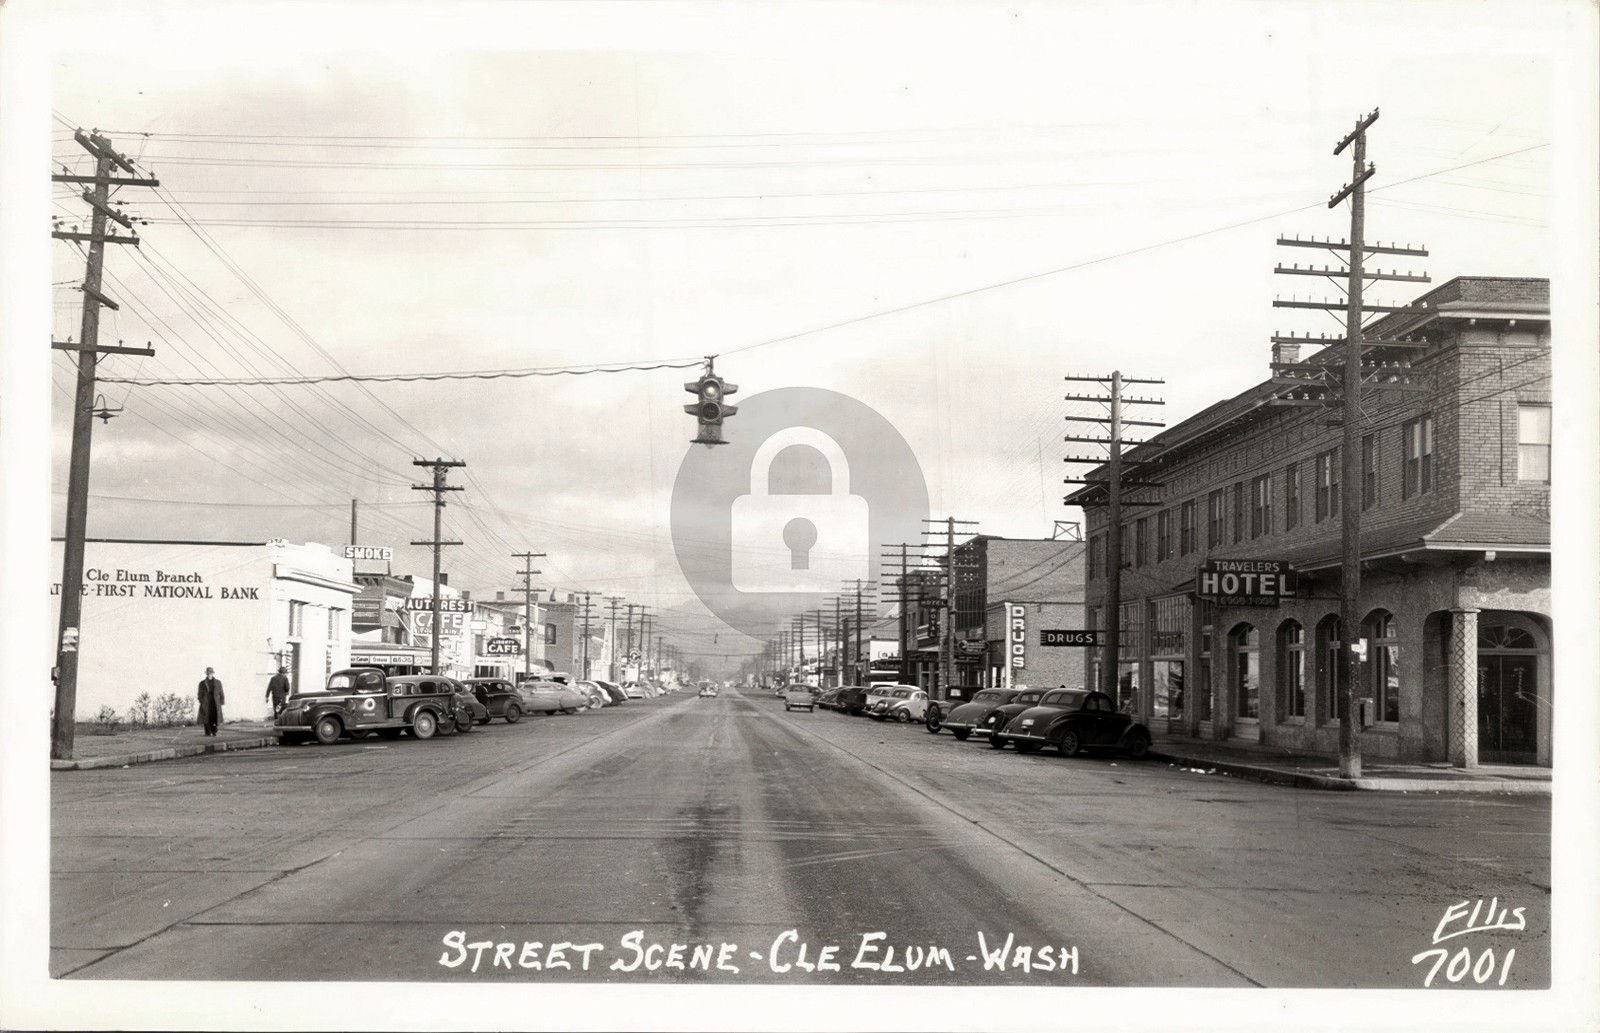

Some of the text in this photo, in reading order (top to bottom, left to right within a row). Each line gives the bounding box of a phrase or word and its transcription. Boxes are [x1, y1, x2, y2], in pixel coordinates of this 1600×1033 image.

[346, 547, 391, 560] SMOKE
[1214, 561, 1280, 572] TRAVELERS
[86, 568, 203, 583] Cle Elum Branch
[1202, 572, 1295, 596] HOTEL
[144, 584, 213, 599] NATIONAL
[221, 587, 259, 600] BANK
[407, 599, 474, 611] AUT REST
[1012, 606, 1025, 668] DRUGS
[1047, 633, 1094, 643] DRUGS
[488, 644, 518, 654] CAFE
